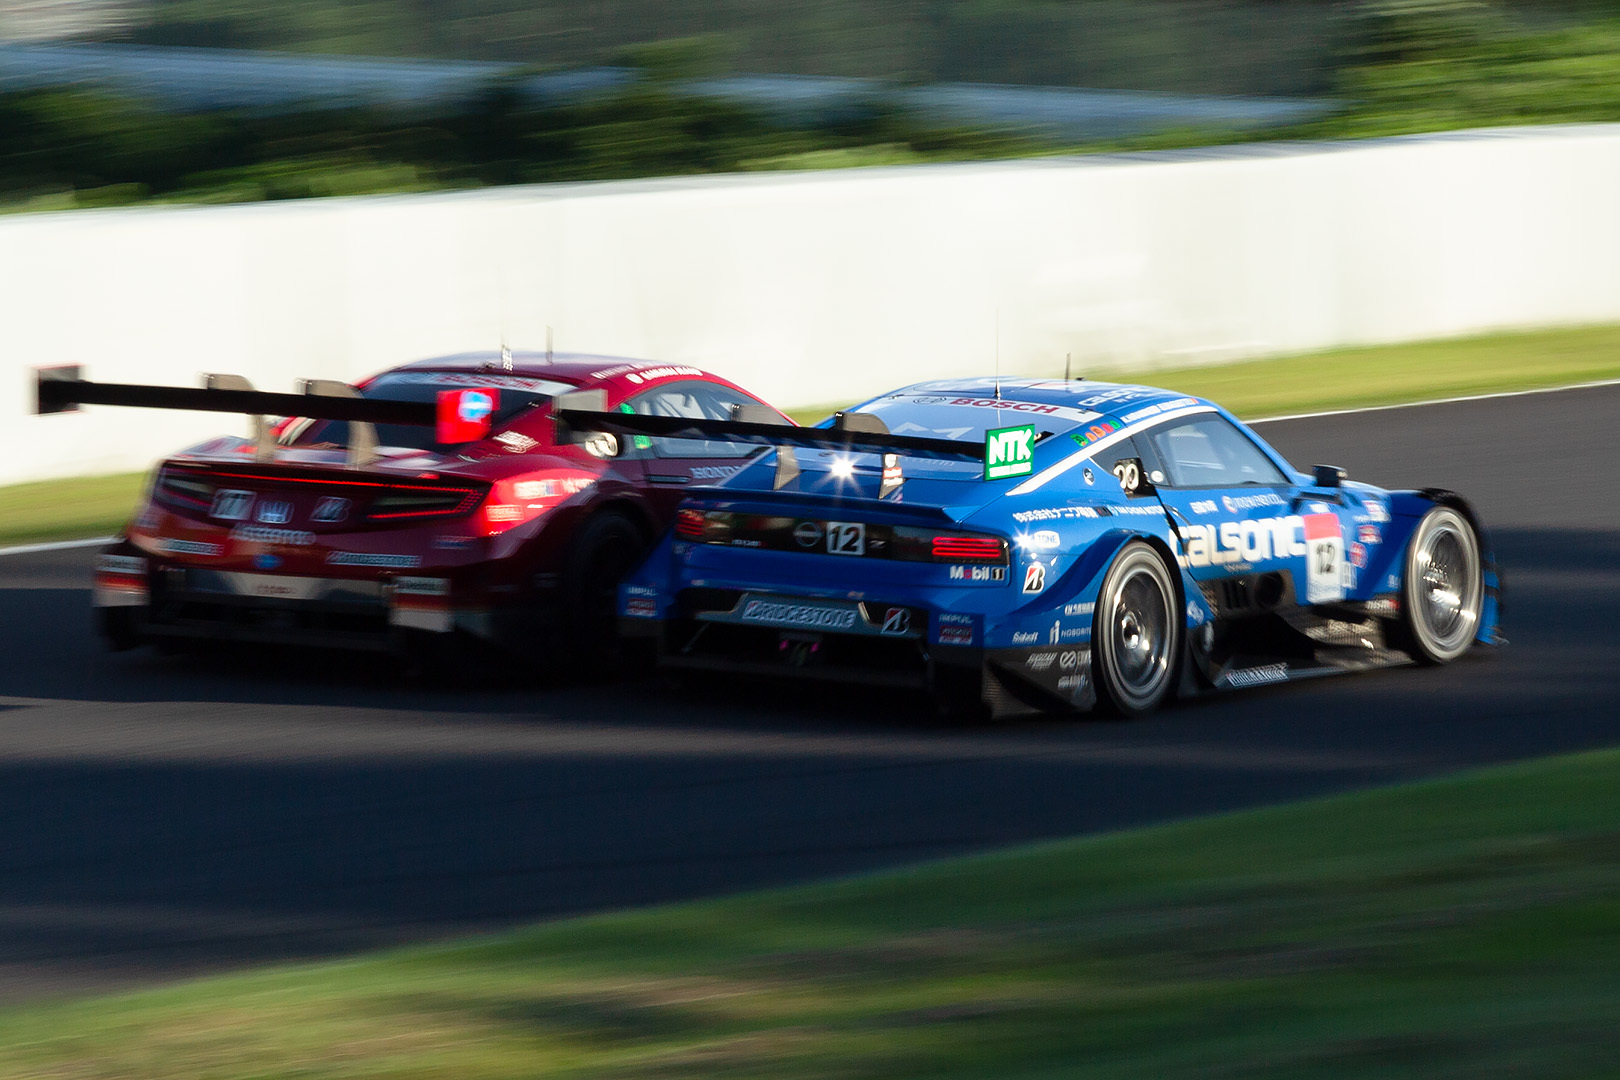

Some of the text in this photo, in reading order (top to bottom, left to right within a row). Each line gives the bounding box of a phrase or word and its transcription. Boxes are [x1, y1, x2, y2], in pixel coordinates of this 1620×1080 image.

[950, 396, 1060, 415] BOSCH
[989, 428, 1033, 465] NTK
[829, 525, 861, 553] 12
[949, 565, 990, 581] Mobil
[742, 600, 857, 629] BRIDGESTONE
